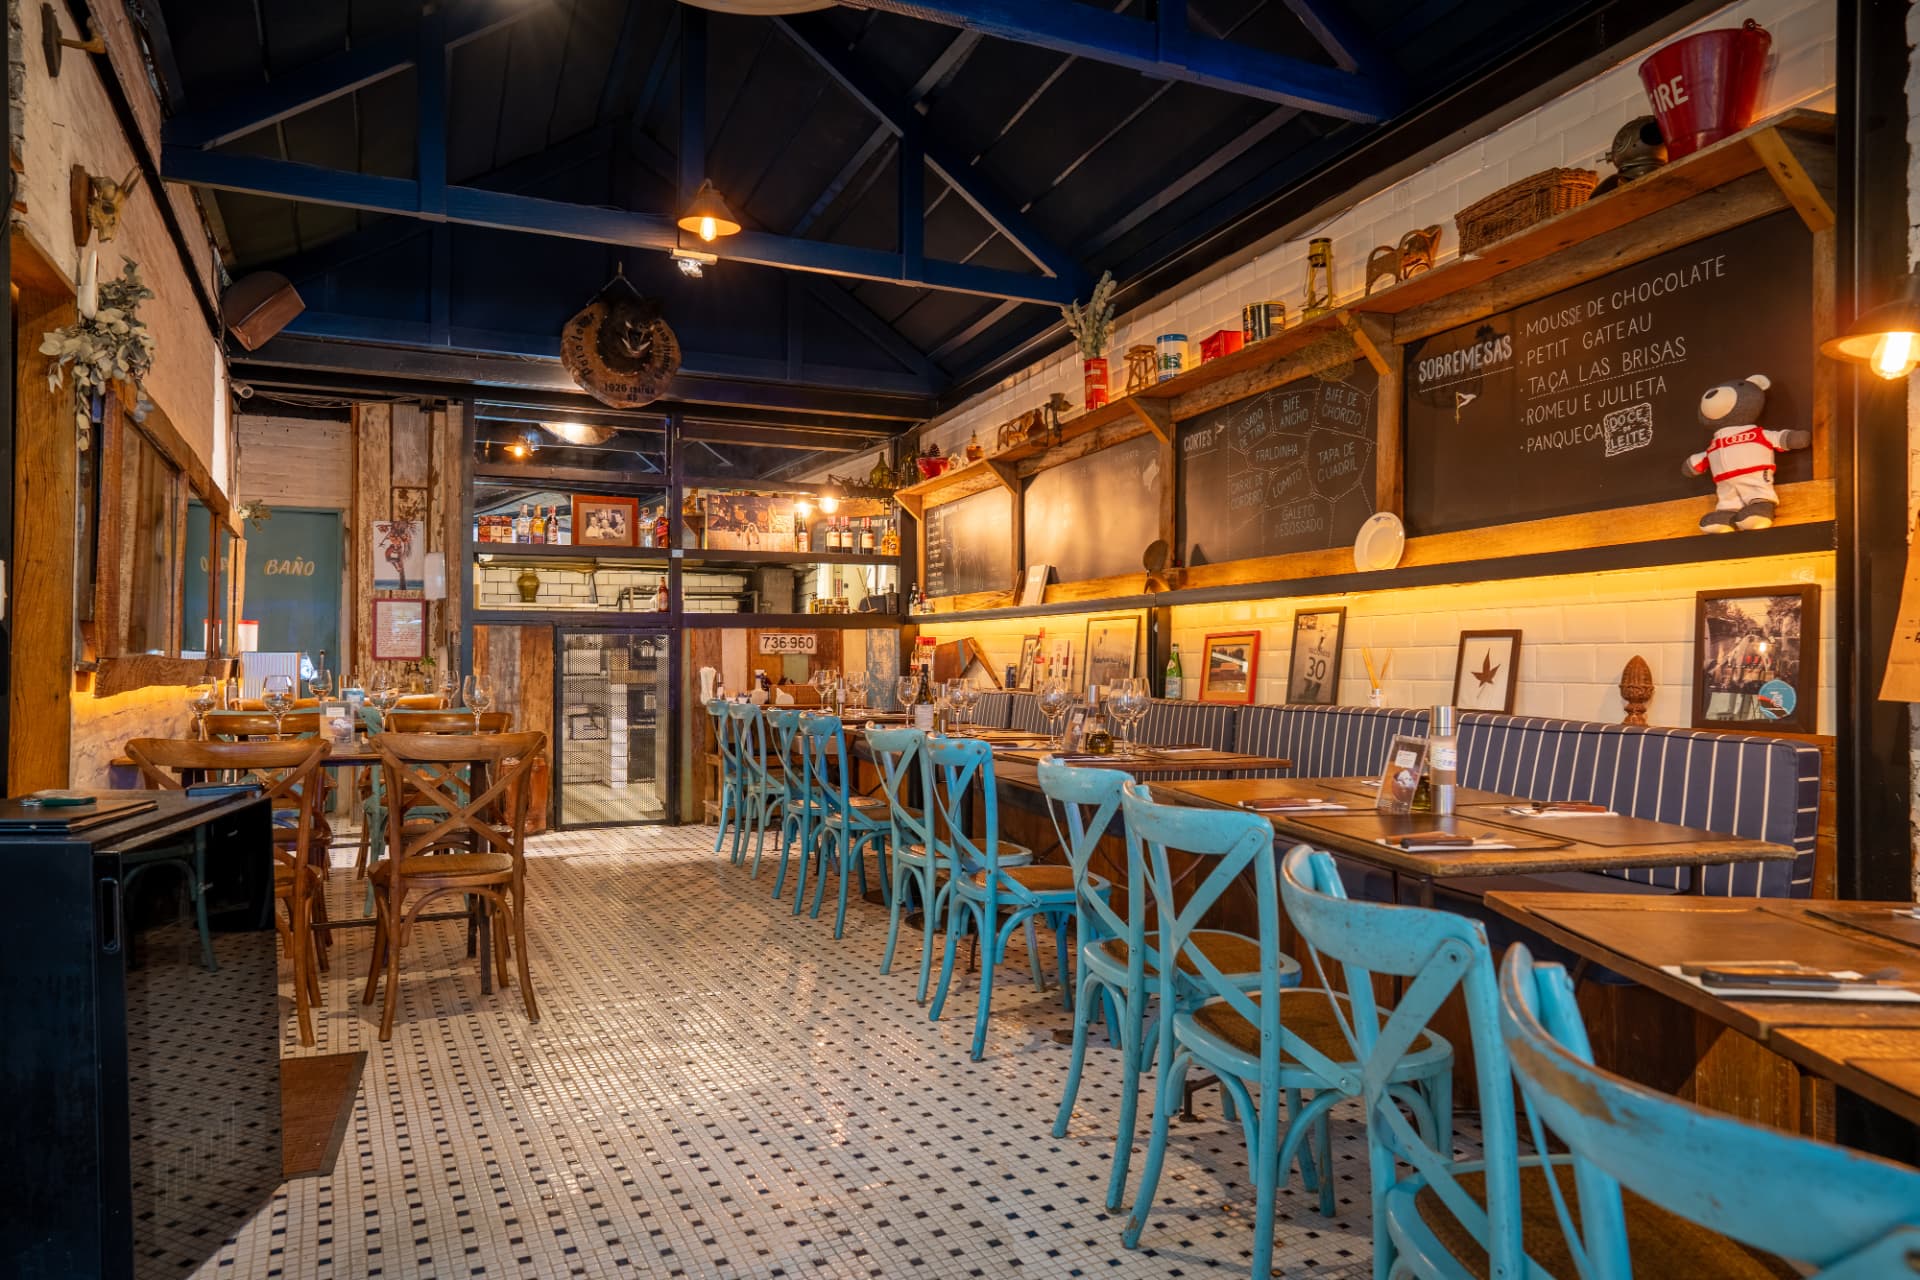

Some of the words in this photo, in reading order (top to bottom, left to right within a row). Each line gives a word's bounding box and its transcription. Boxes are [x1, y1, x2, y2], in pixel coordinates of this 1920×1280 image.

[1525, 305, 1583, 336] MOUSSE
[1587, 297, 1606, 316] DE
[1610, 254, 1727, 311] CHOCOLATE
[1526, 342, 1567, 367] PETIT
[1582, 313, 1652, 350] GATEAU
[1419, 335, 1513, 384] SOBREMESAS
[1527, 370, 1569, 397] TAÇA
[1579, 357, 1611, 383] LAS
[1622, 336, 1687, 371] BRISAS
[1282, 395, 1301, 413] BIFE
[1325, 387, 1344, 403] BIFE
[1347, 392, 1358, 408] DE
[1525, 397, 1578, 427] ROMEU
[1583, 396, 1592, 413] E
[1597, 375, 1668, 408] JULIETA
[1279, 408, 1309, 428] ANCHO
[1321, 406, 1362, 426] CHORIZO
[1609, 408, 1645, 429] DOCE
[1183, 430, 1213, 451] CORTES
[1239, 434, 1249, 449] DE
[1526, 422, 1604, 453] PANQUECA
[1610, 428, 1647, 449] LEITE
[1255, 442, 1299, 463] FRALDINHA
[1317, 447, 1341, 463] TAPA
[1343, 441, 1356, 457] DE
[1316, 459, 1359, 483] CUADRIL
[1272, 468, 1303, 498] LOMITO
[1281, 503, 1315, 522] GALETO
[264, 555, 316, 577] BAÑO
[1306, 656, 1327, 681] 30
